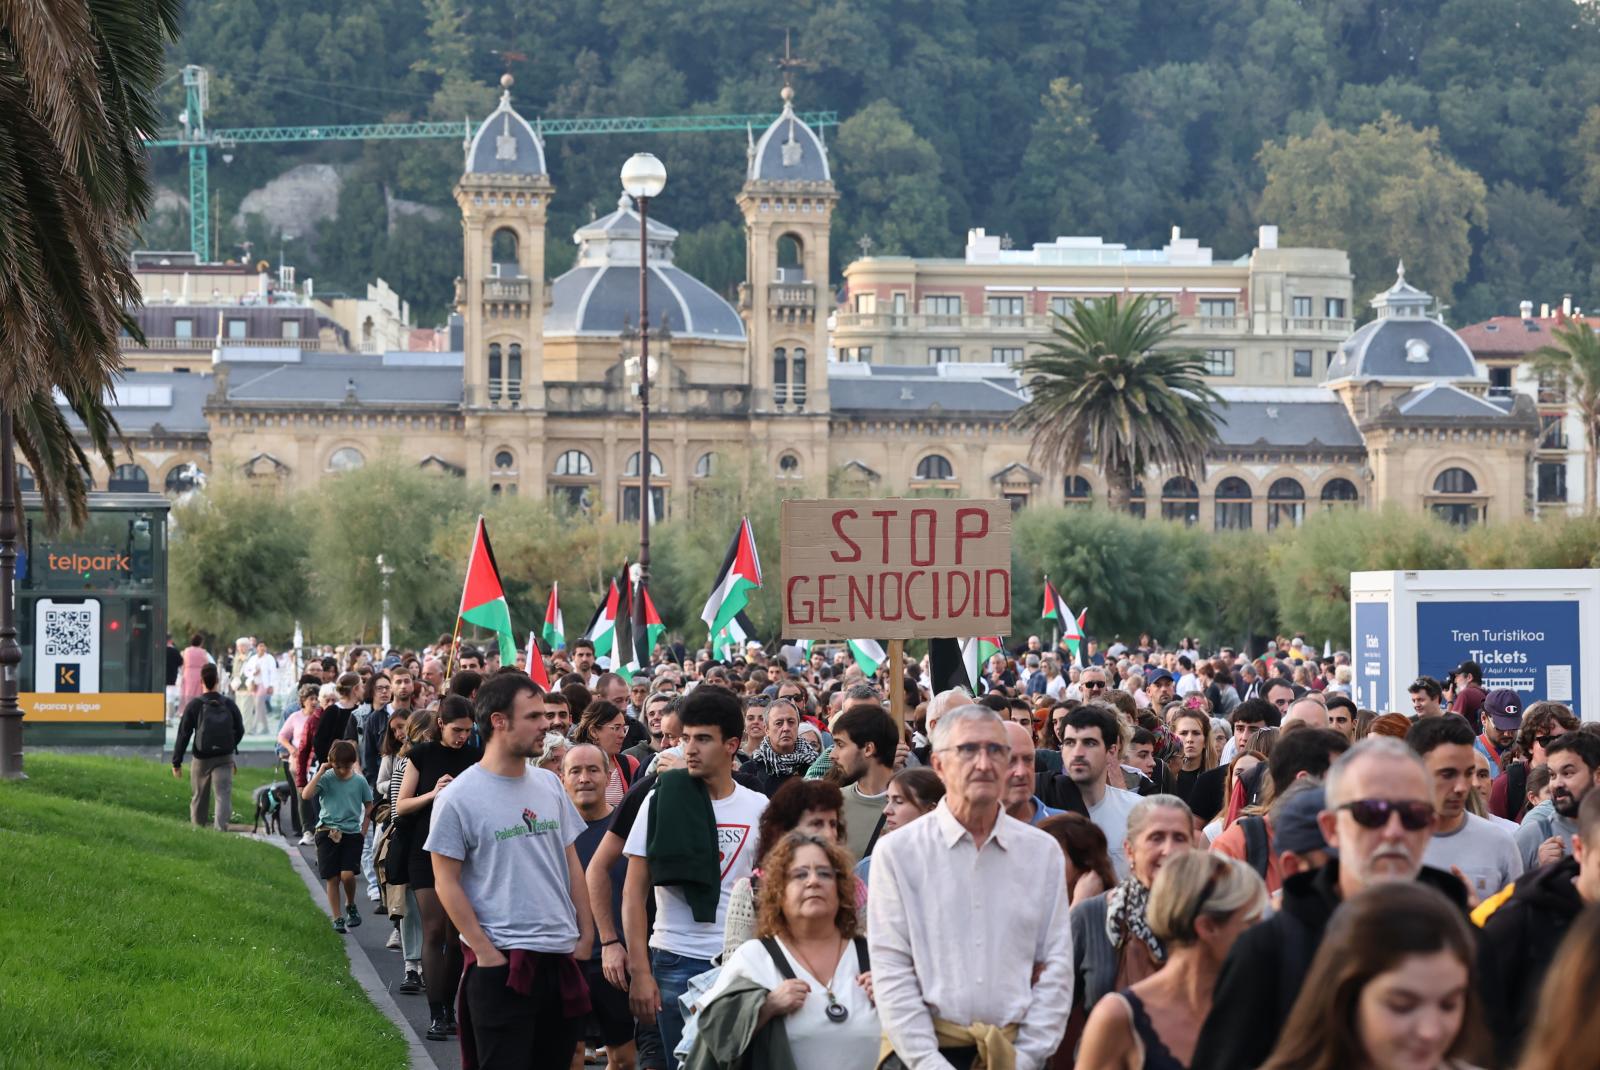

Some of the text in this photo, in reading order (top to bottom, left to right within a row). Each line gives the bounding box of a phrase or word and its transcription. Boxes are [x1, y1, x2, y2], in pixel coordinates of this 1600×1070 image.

[830, 507, 989, 567] STOP
[48, 553, 129, 574] telpark
[787, 568, 1010, 625] GENOCIDIO
[1451, 629, 1545, 641] Tren Turistikoa
[1469, 650, 1527, 663] Tickets
[33, 703, 101, 713] Aparca y sigue
[717, 829, 741, 843] ESS
